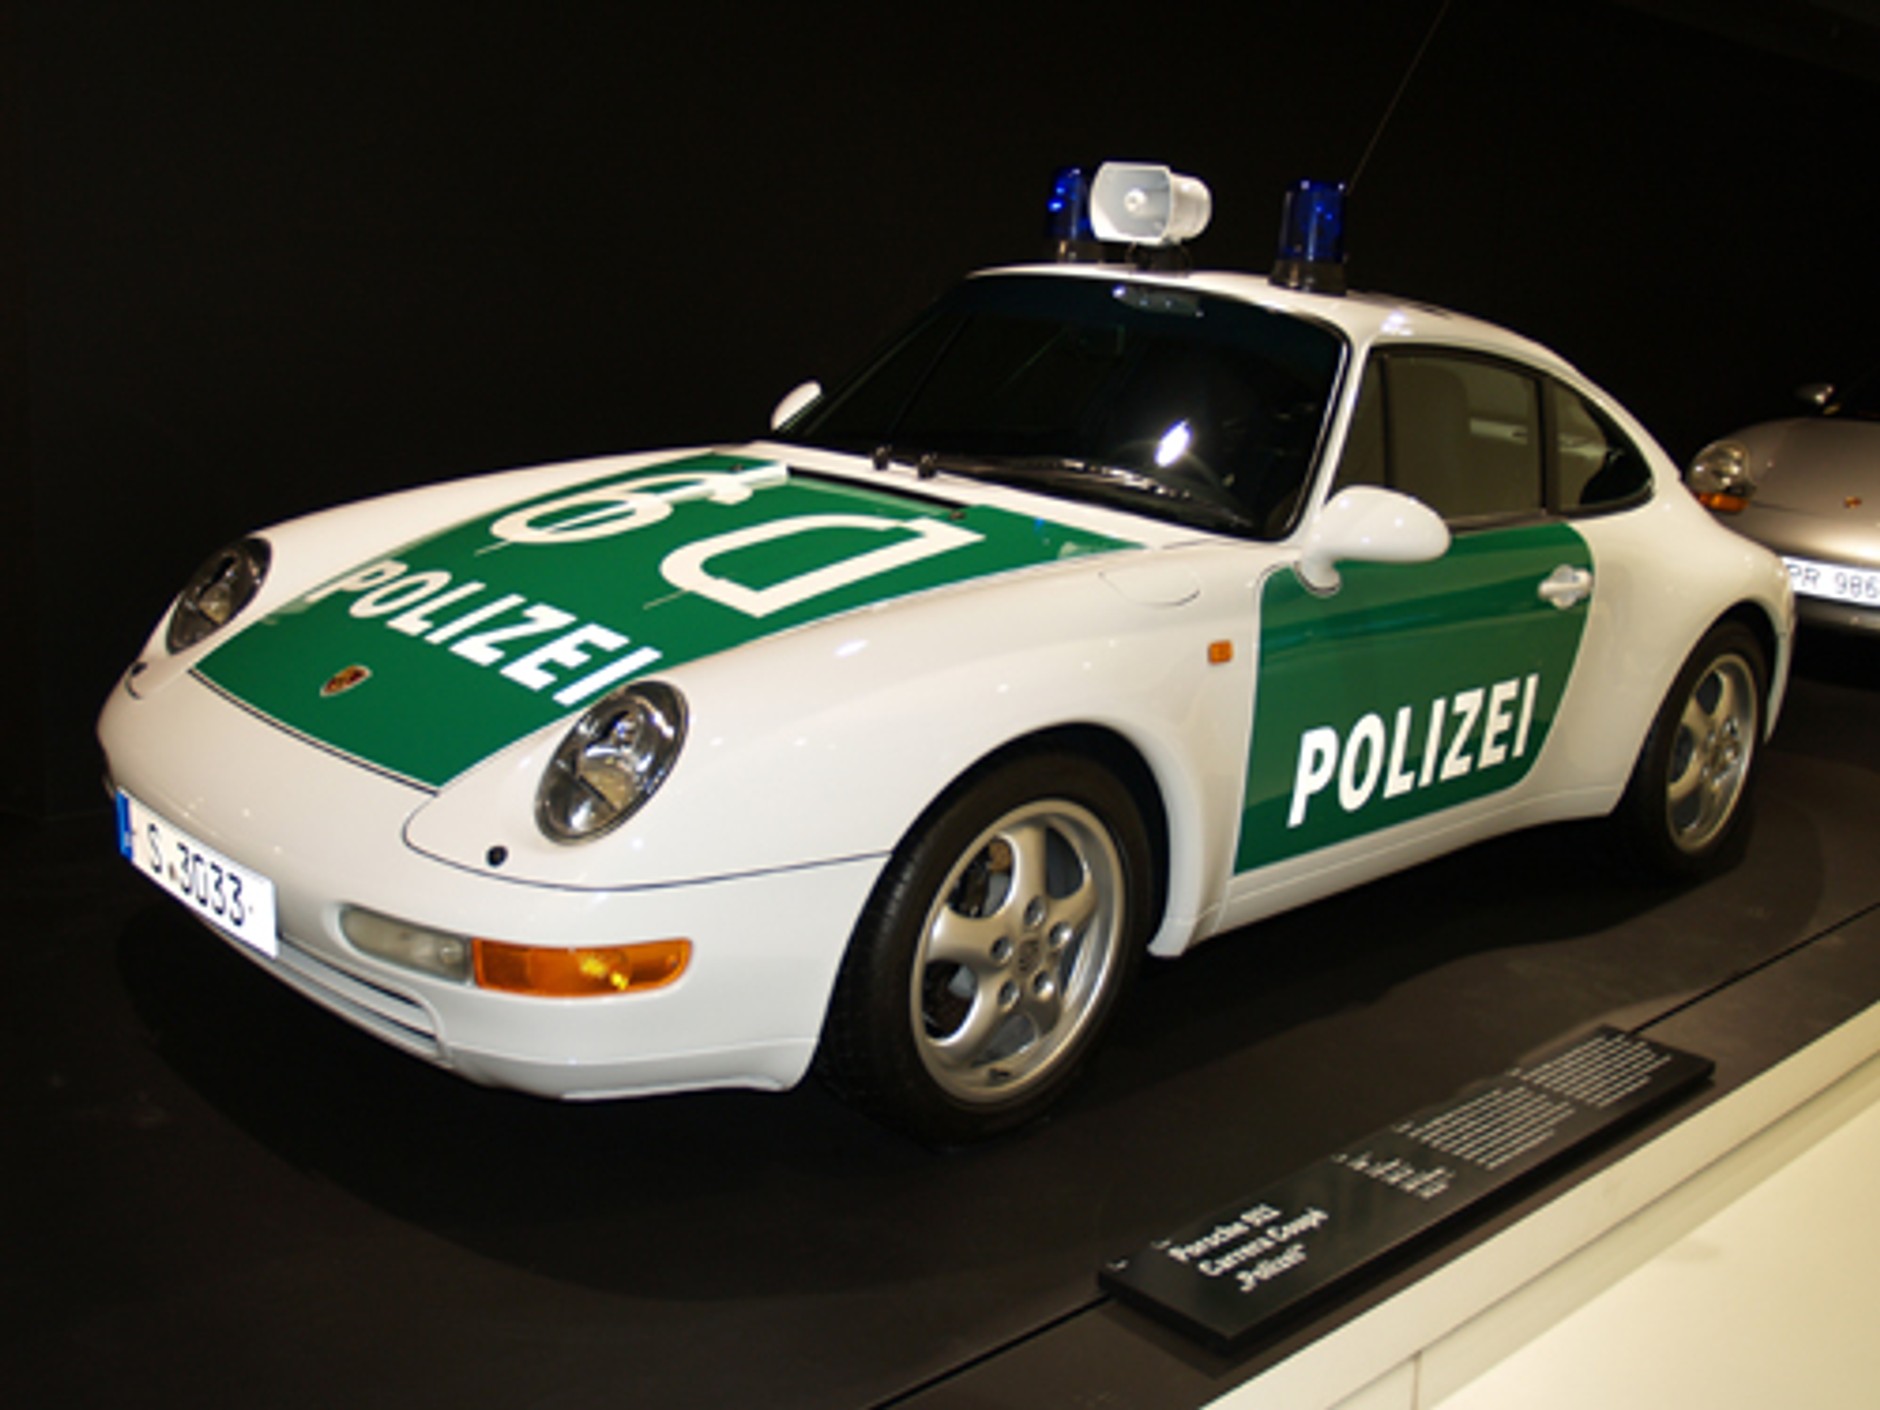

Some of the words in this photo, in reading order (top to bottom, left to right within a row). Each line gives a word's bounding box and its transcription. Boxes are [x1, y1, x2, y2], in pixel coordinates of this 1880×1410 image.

[1835, 571, 1879, 598] 986
[305, 559, 664, 706] POLIZEI
[1286, 672, 1540, 829] POLIZEI
[1167, 1220, 1250, 1264] Porsche
[1198, 1236, 1276, 1277] Carrera
